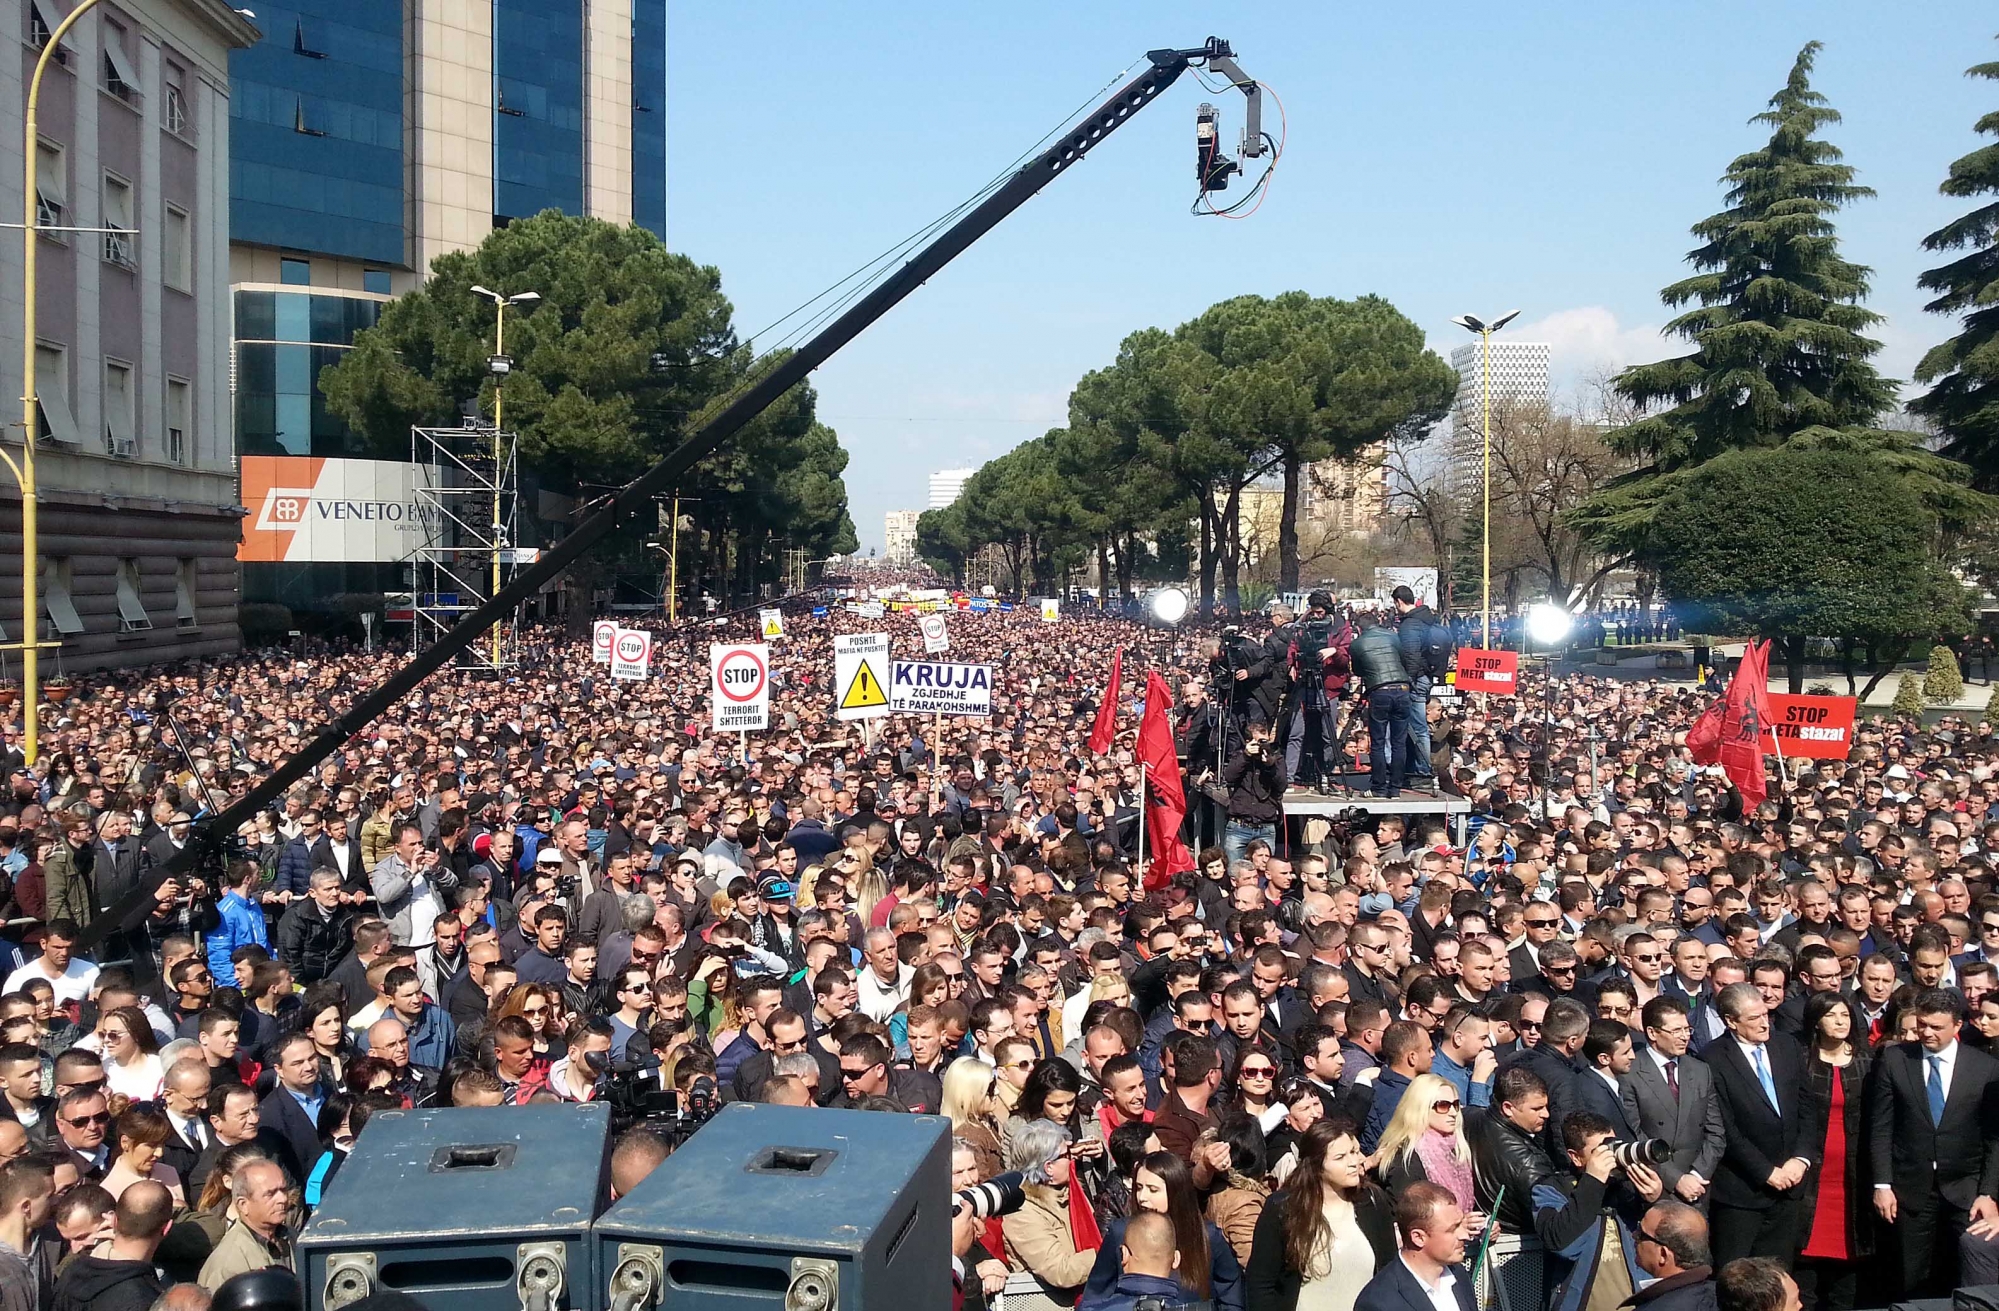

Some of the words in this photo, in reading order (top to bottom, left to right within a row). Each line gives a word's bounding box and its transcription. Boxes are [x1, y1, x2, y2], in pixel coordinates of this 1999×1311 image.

[317, 501, 402, 521] VENETO
[927, 624, 941, 633] STOP
[621, 642, 642, 653] STOP
[1475, 657, 1502, 670] STOP
[724, 668, 758, 684] STOP
[895, 663, 989, 690] KRUJA
[912, 688, 967, 700] ZGJEDHJE
[723, 705, 760, 715] TERRORIT
[892, 697, 905, 709] TË
[909, 699, 988, 713] PARAKOHSHME
[1786, 705, 1829, 723] STOP
